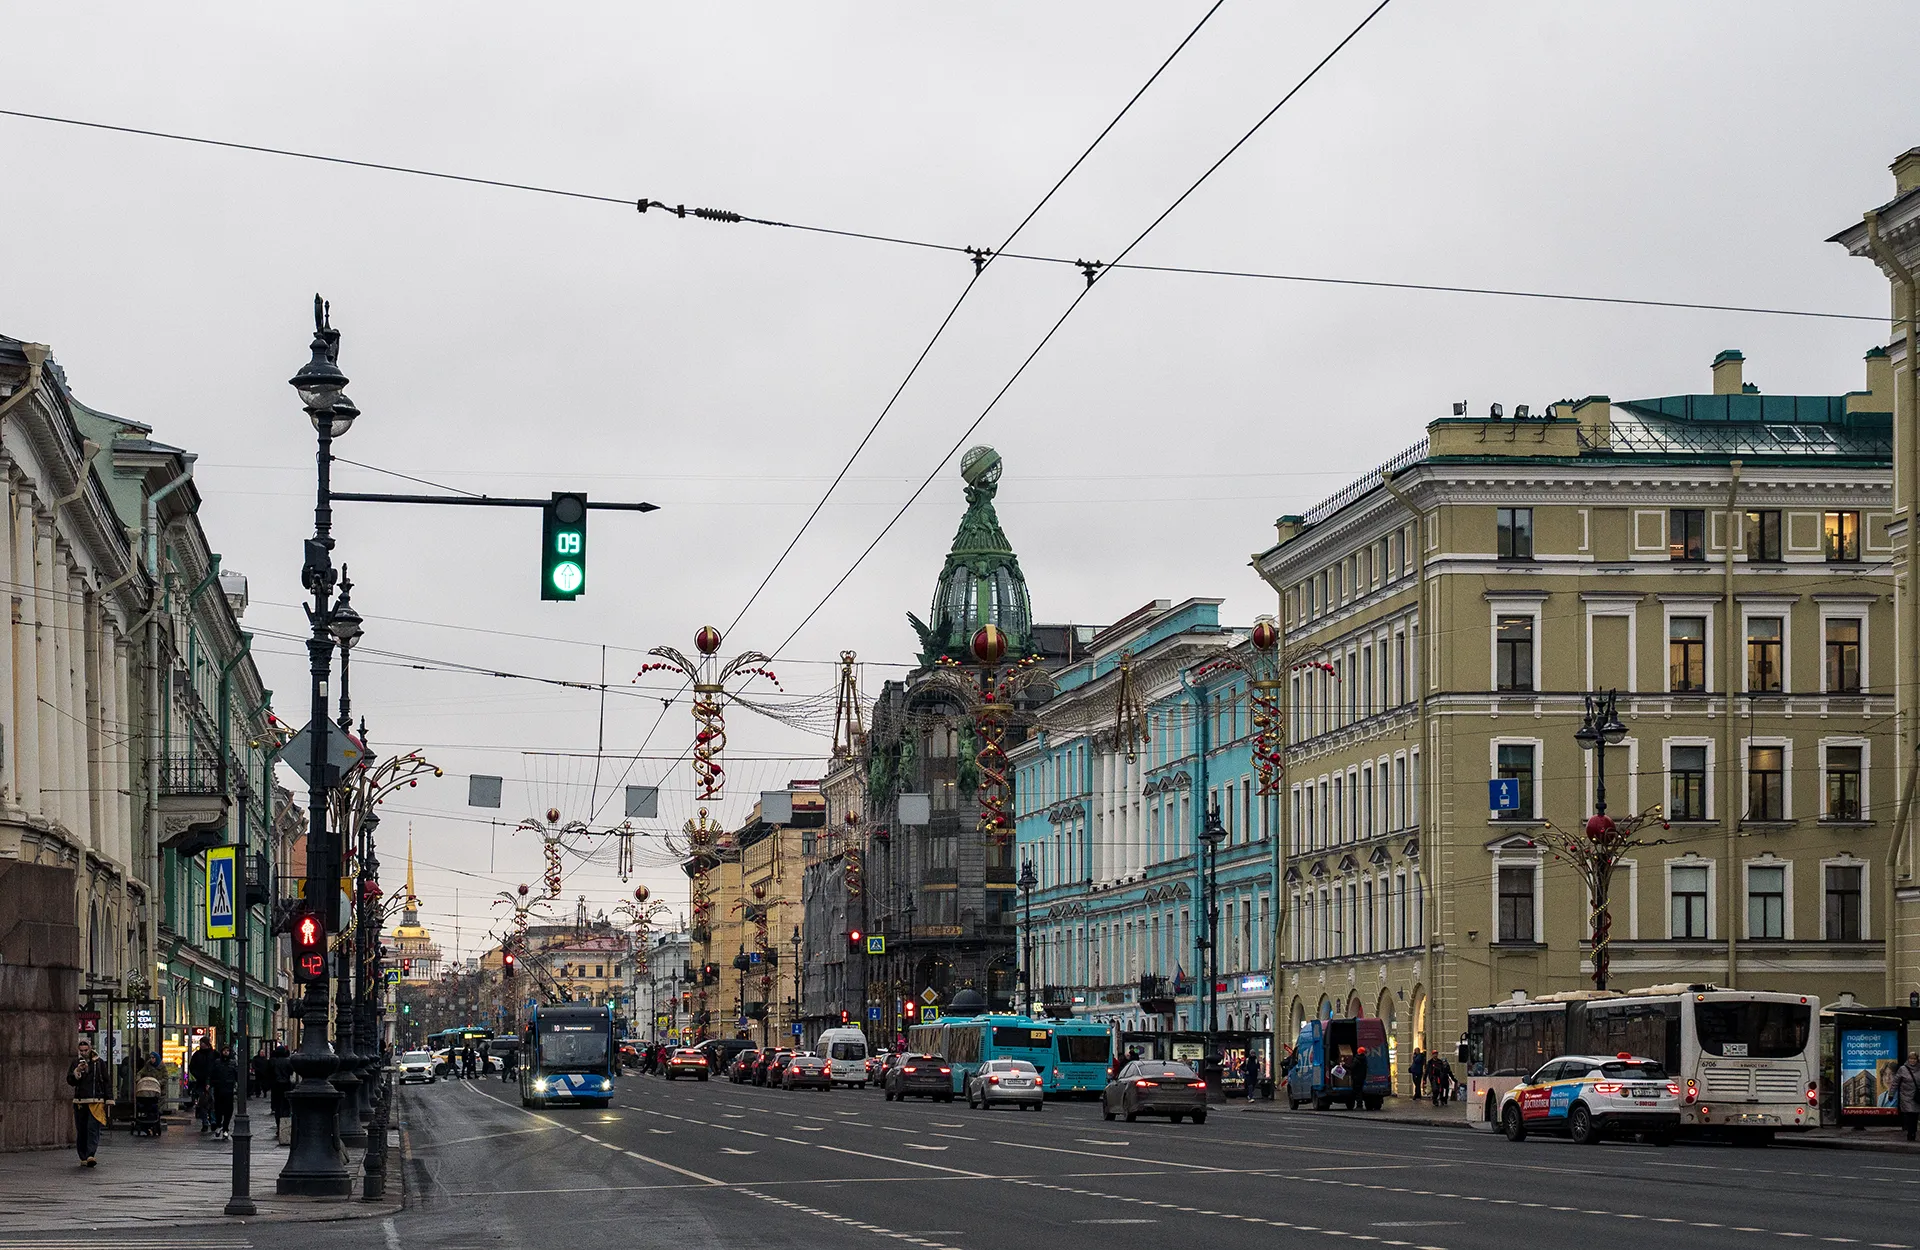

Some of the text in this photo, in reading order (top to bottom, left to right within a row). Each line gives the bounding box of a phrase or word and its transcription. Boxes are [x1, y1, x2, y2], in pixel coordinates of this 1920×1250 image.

[557, 533, 580, 553] 09
[302, 956, 322, 975] 42
[1847, 1034, 1881, 1042] подберёт
